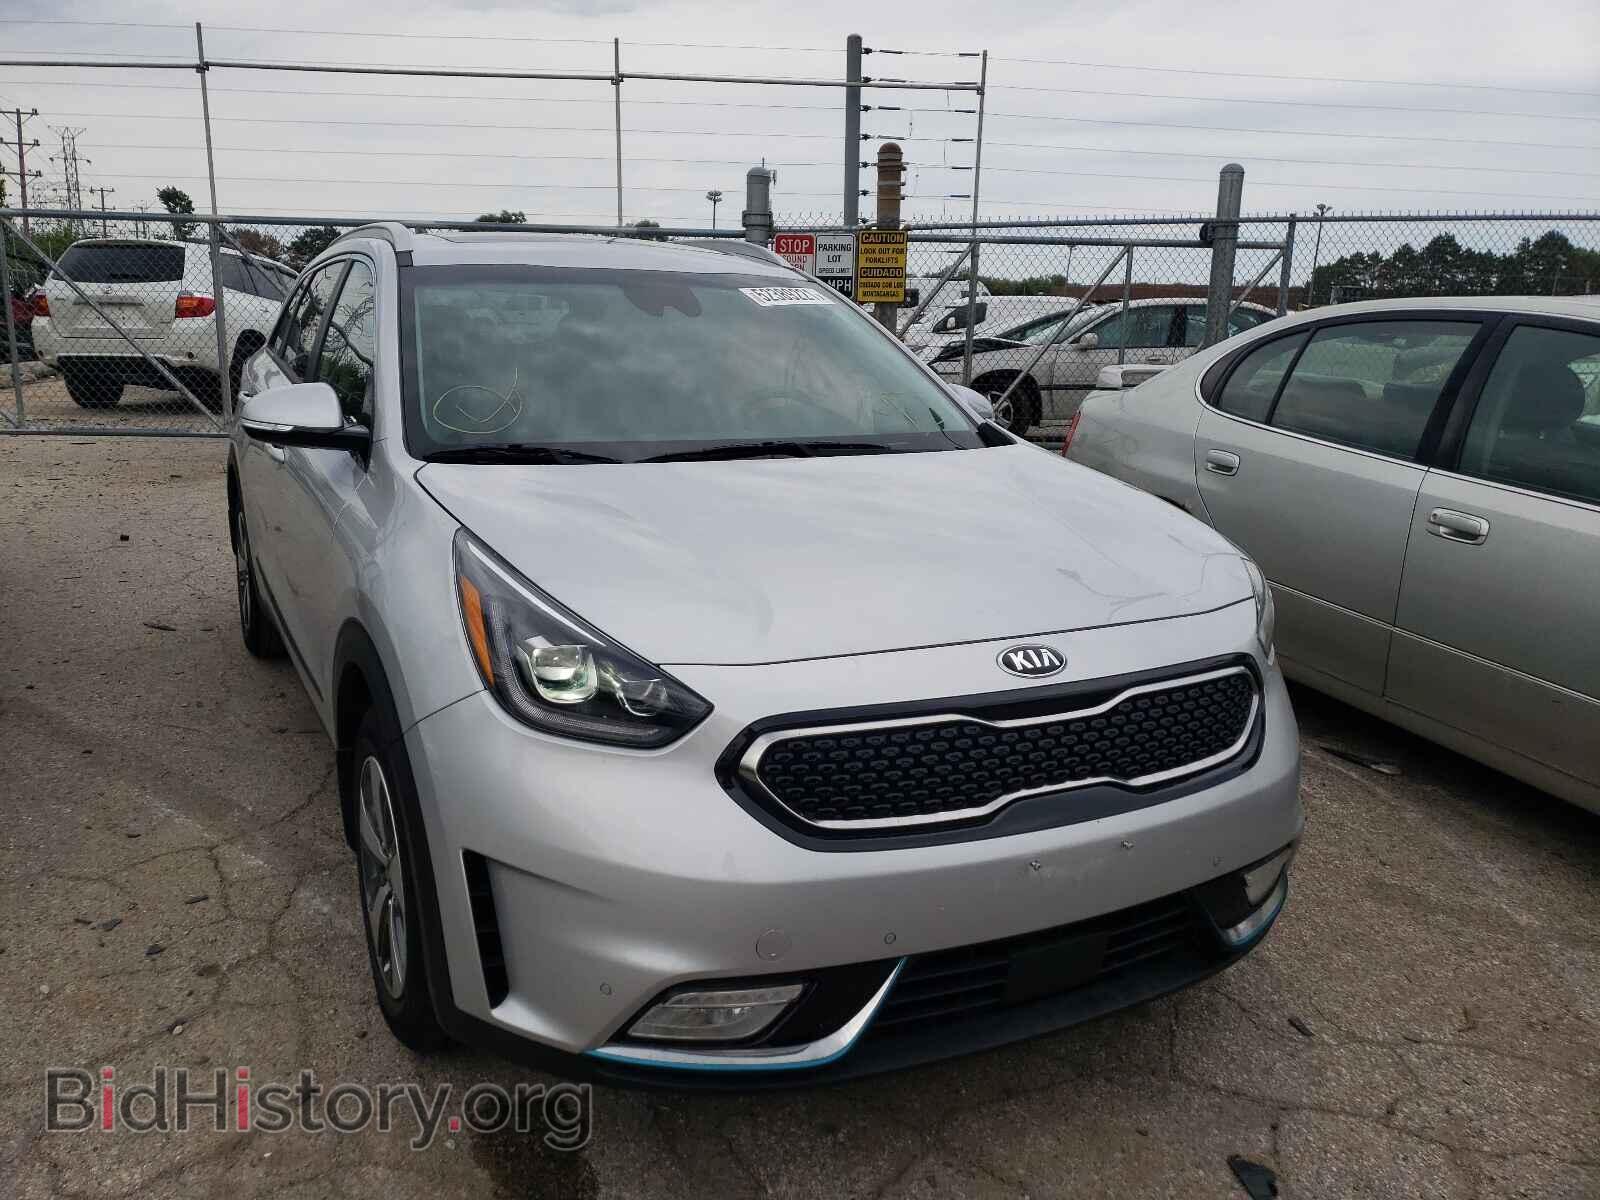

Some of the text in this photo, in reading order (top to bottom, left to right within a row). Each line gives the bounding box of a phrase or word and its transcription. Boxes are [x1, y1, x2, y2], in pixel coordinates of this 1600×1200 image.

[863, 233, 904, 243] CAUTION
[779, 239, 810, 253] STOP
[818, 243, 852, 252] PARKING
[892, 247, 905, 255] FOR
[827, 254, 842, 263] LOT
[865, 256, 899, 264] FORKLIFTS
[861, 268, 903, 277] CUIDADO
[1007, 648, 1061, 671] KIA
